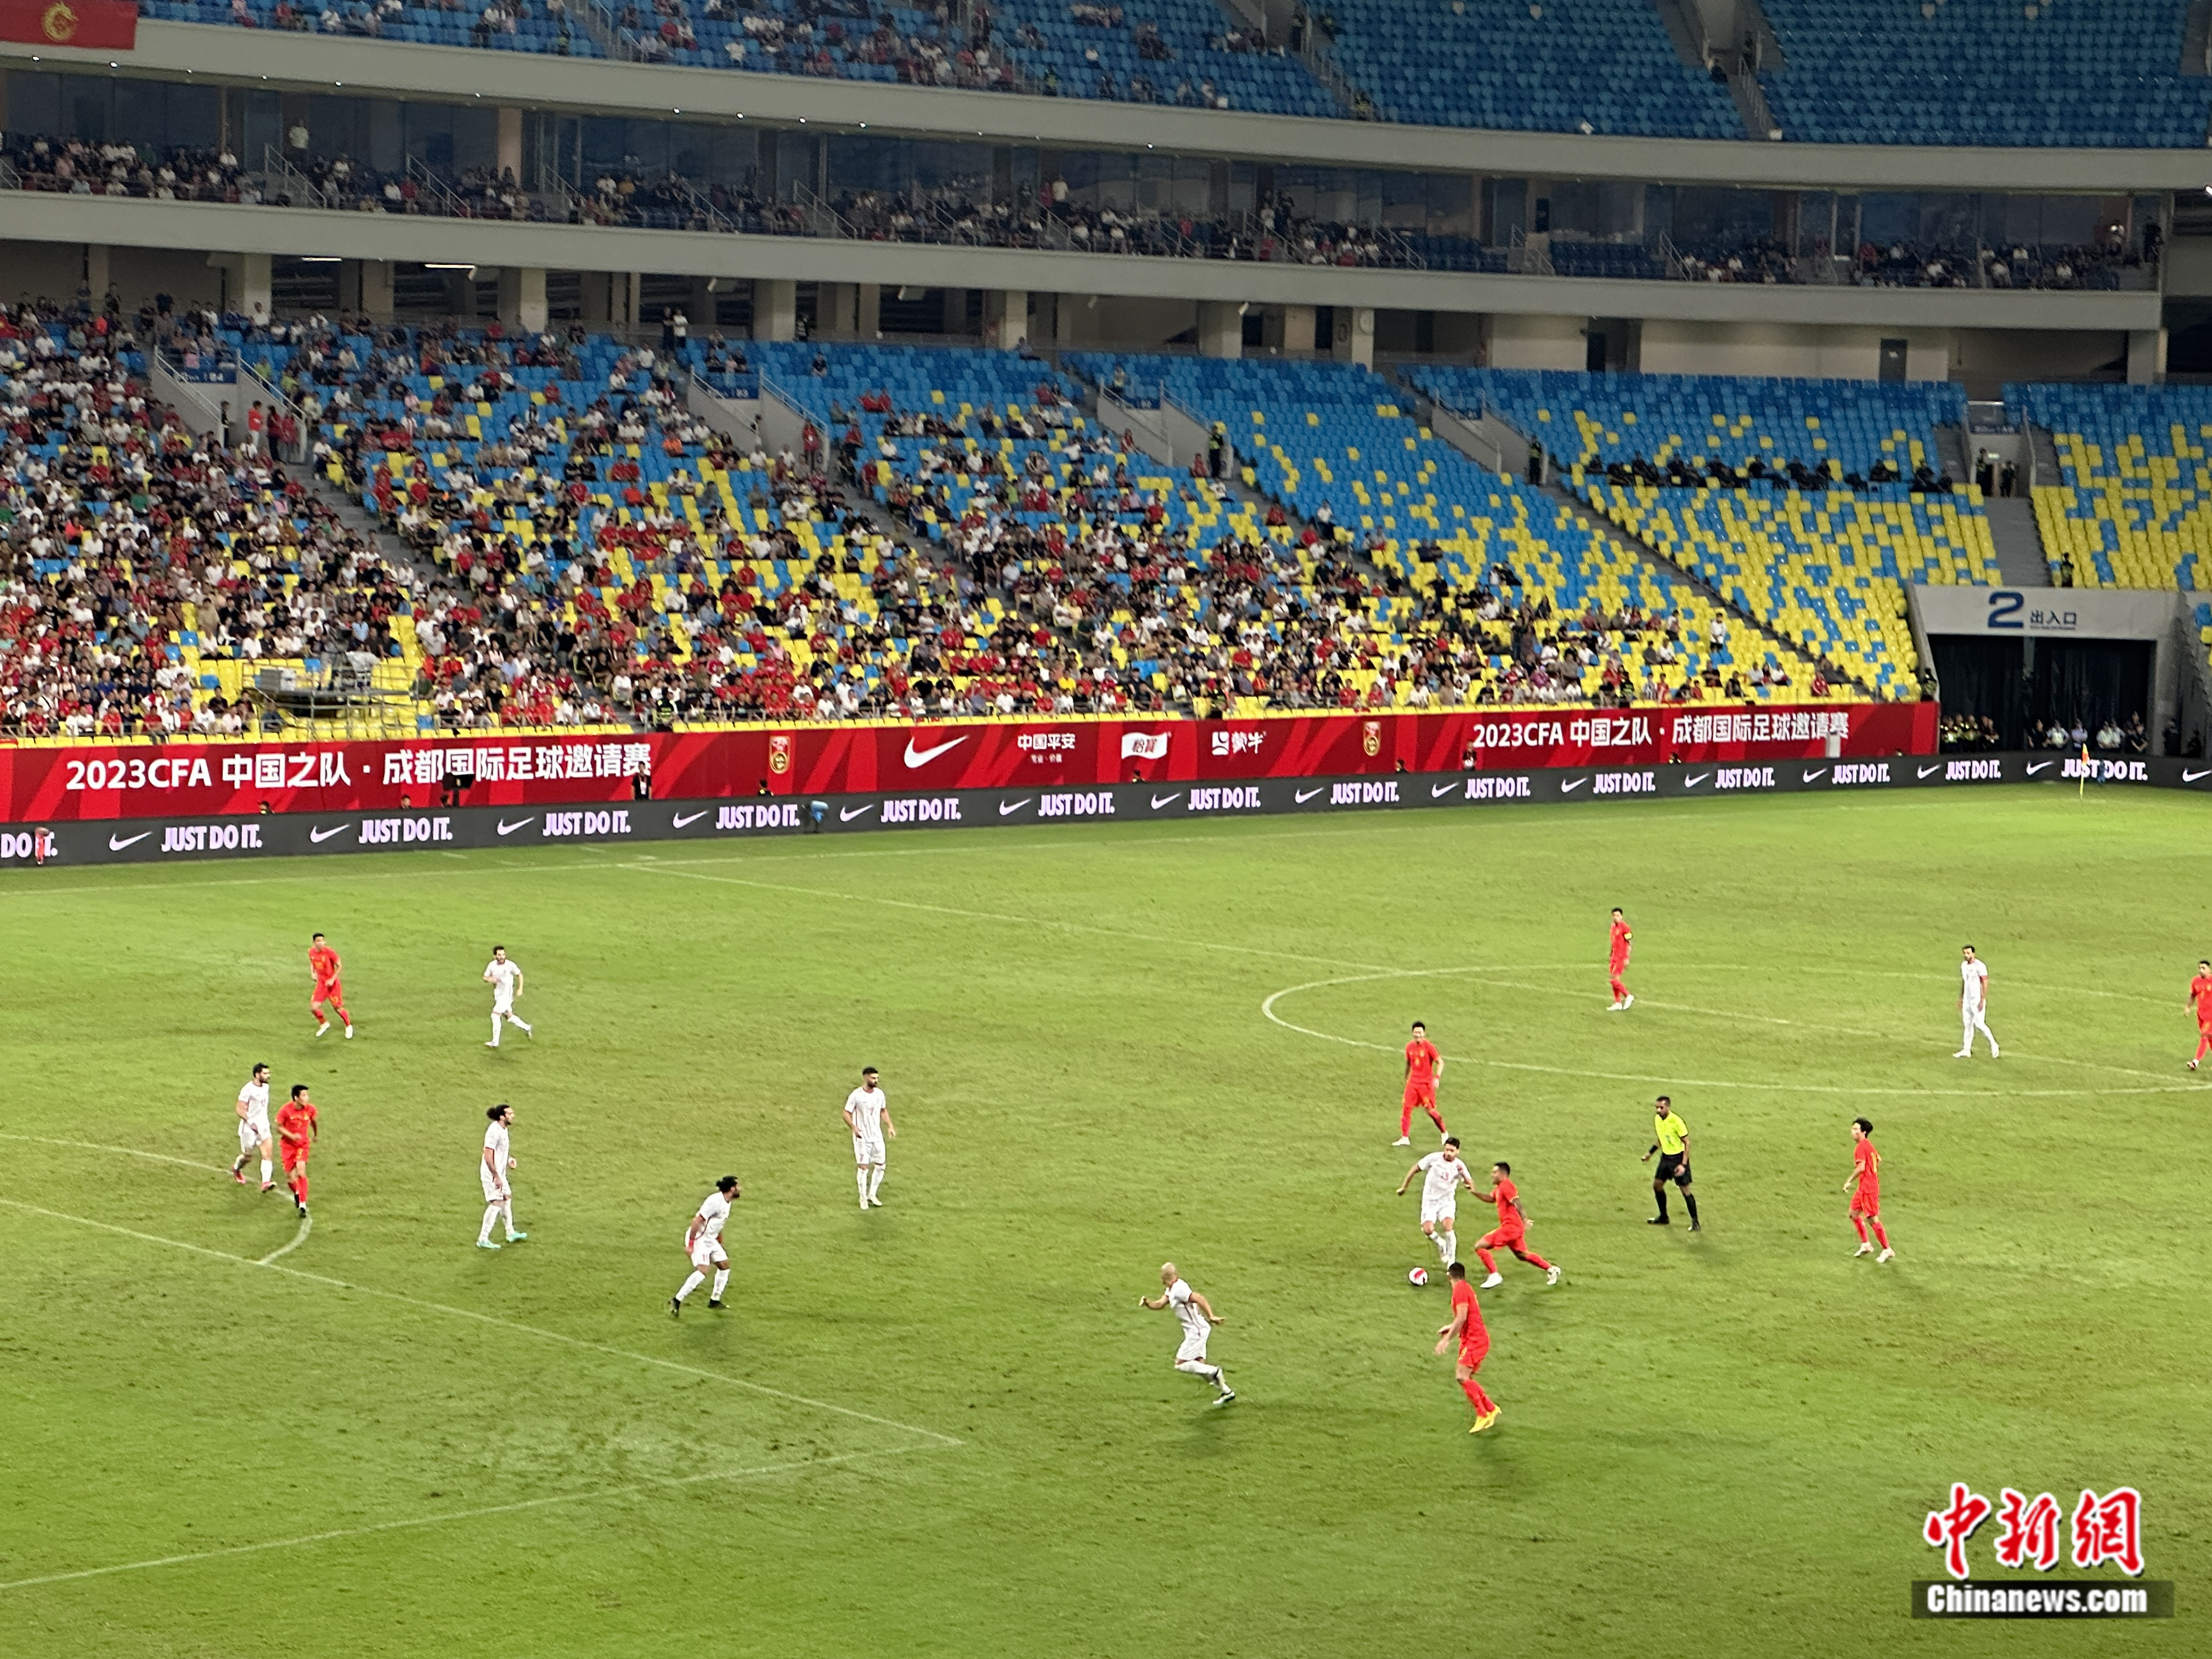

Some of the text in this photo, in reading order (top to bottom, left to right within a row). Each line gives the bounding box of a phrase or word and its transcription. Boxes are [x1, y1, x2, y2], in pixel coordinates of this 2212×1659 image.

[1988, 591, 2024, 628] 2
[2030, 610, 2077, 625] 出入口
[1017, 732, 1075, 751] 中国平安
[1473, 723, 1564, 747] 2023CFA
[66, 759, 212, 790] 2023CFA
[1715, 768, 1775, 788] JUST DO IT.
[1832, 764, 1891, 784] JUST DO IT.
[1946, 760, 2001, 780] JUST DO IT.
[2061, 759, 2148, 781] JUST DO IT.
[1330, 781, 1400, 804] JUST DO IT.
[1465, 777, 1531, 799] JUST DO IT.
[1593, 772, 1656, 793] JUST DO IT.
[881, 798, 961, 822] JUST DO IT.
[1039, 793, 1115, 816] JUST DO IT.
[1188, 787, 1261, 810] JUST DO IT.
[543, 810, 631, 836] JUST DO IT.
[716, 804, 800, 829] JUST DO IT.
[161, 824, 263, 851] JUST DO IT.
[359, 817, 453, 843] JUST DO IT.
[1, 832, 33, 858] DO
